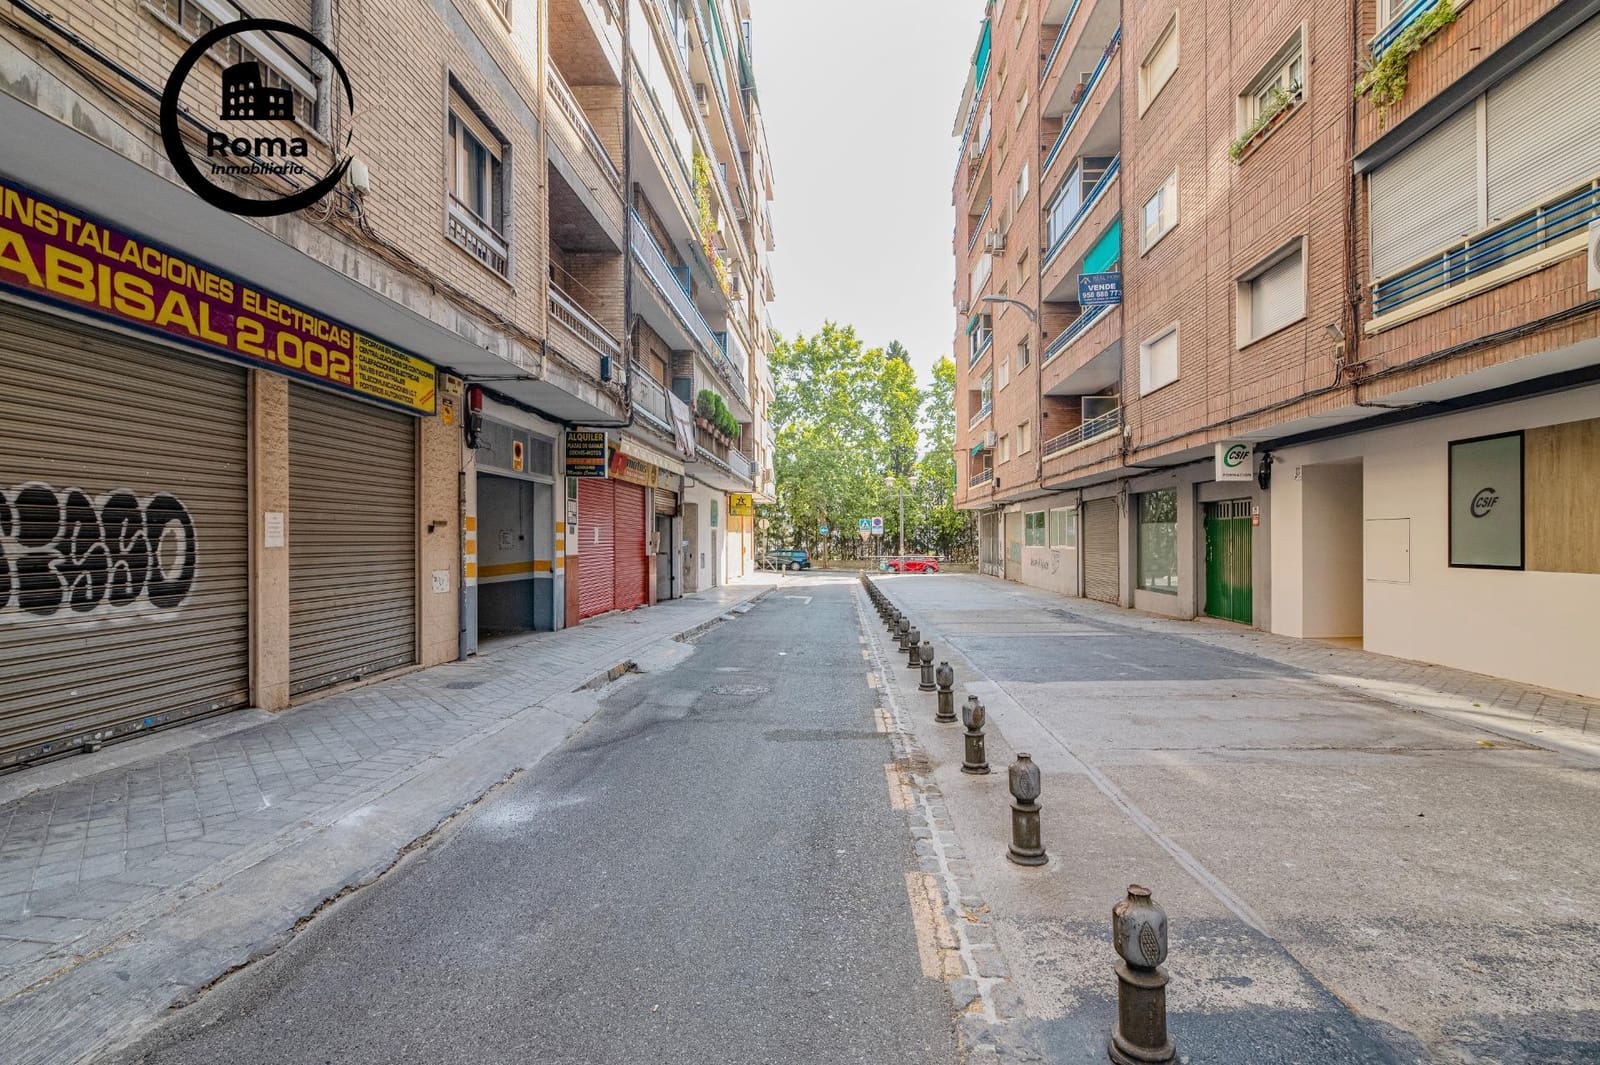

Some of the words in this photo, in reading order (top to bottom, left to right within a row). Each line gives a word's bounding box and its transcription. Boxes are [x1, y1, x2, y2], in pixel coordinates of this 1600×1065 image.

[0, 185, 234, 304] INSTALACIONES
[242, 287, 350, 349] ELECTRICAS
[1088, 283, 1116, 291] VENDE
[0, 226, 228, 345] ABISAL
[236, 316, 350, 382] 2.002
[568, 432, 604, 442] ALQUILER
[1229, 450, 1250, 460] CSIF
[1475, 496, 1499, 508] CSIF
